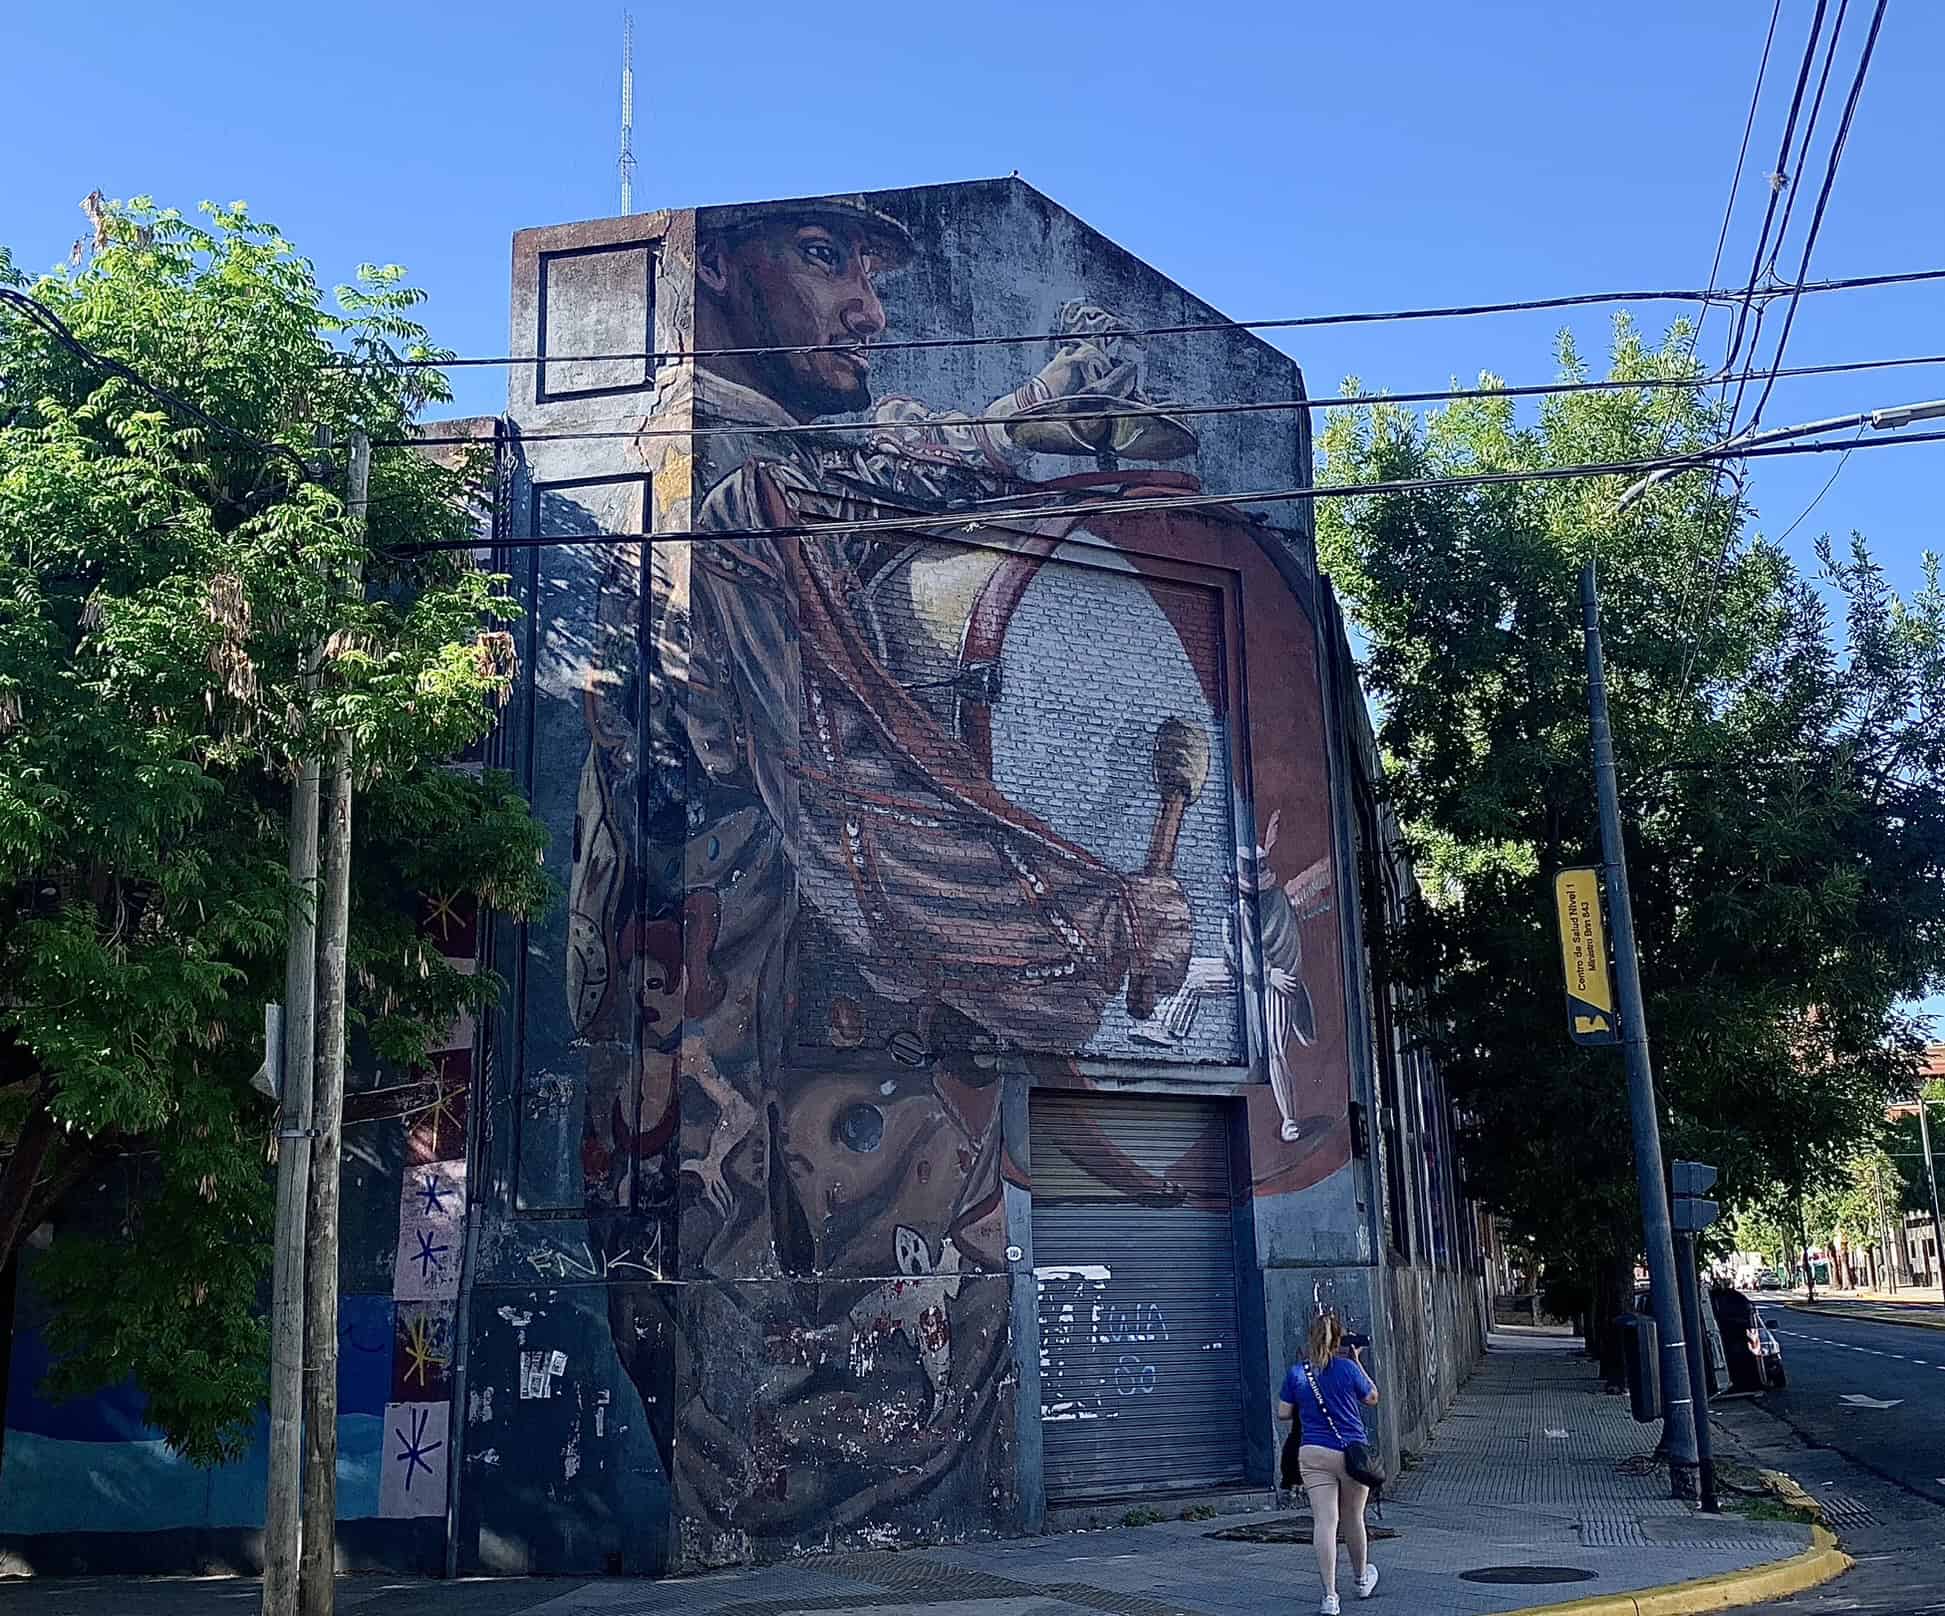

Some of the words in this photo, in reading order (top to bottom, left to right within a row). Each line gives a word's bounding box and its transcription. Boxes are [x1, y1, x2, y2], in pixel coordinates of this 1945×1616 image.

[1566, 890, 1578, 916] Nivel
[1570, 917, 1581, 943] Salud
[1573, 945, 1582, 958] de
[1576, 960, 1586, 991] Centro
